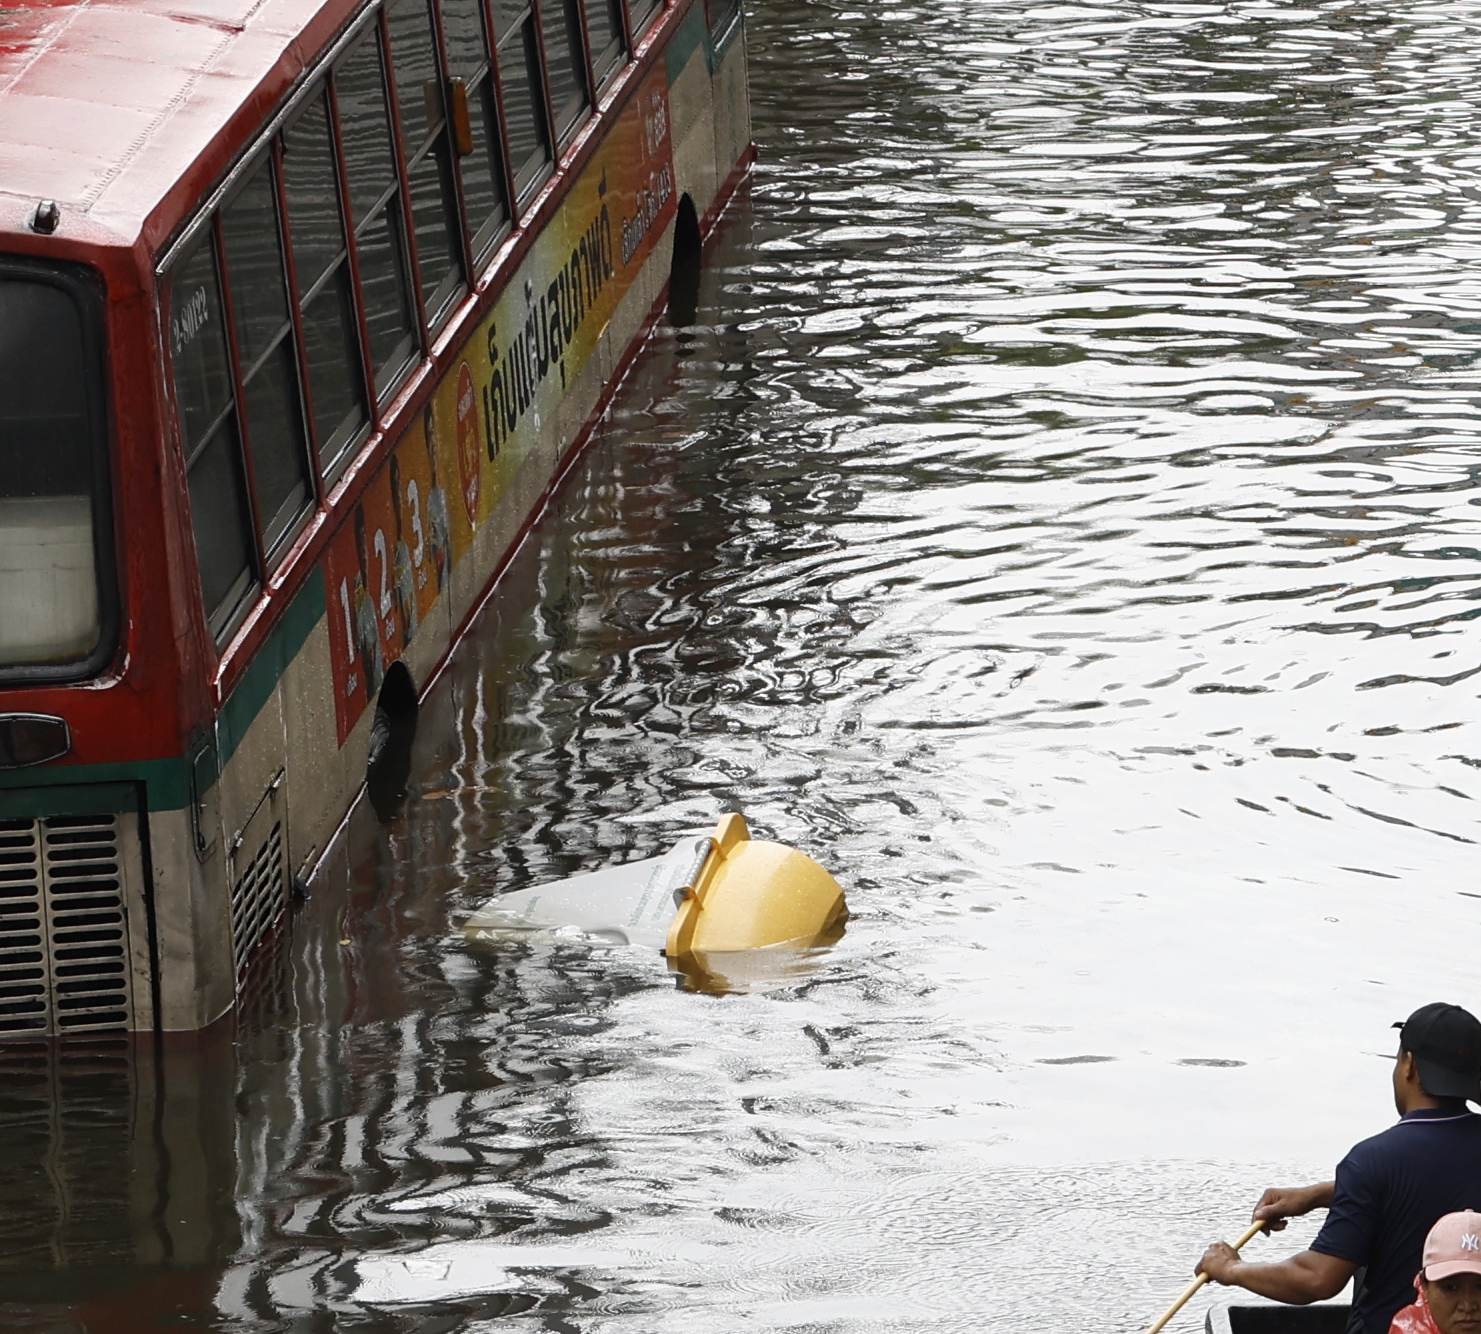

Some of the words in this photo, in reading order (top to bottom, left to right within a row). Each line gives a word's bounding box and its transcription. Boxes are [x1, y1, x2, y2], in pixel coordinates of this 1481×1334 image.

[173, 286, 208, 353] 2-80122
[407, 479, 424, 567] 3
[374, 528, 392, 619] 2
[340, 576, 355, 664] 1
[1461, 1233, 1480, 1251] NY
